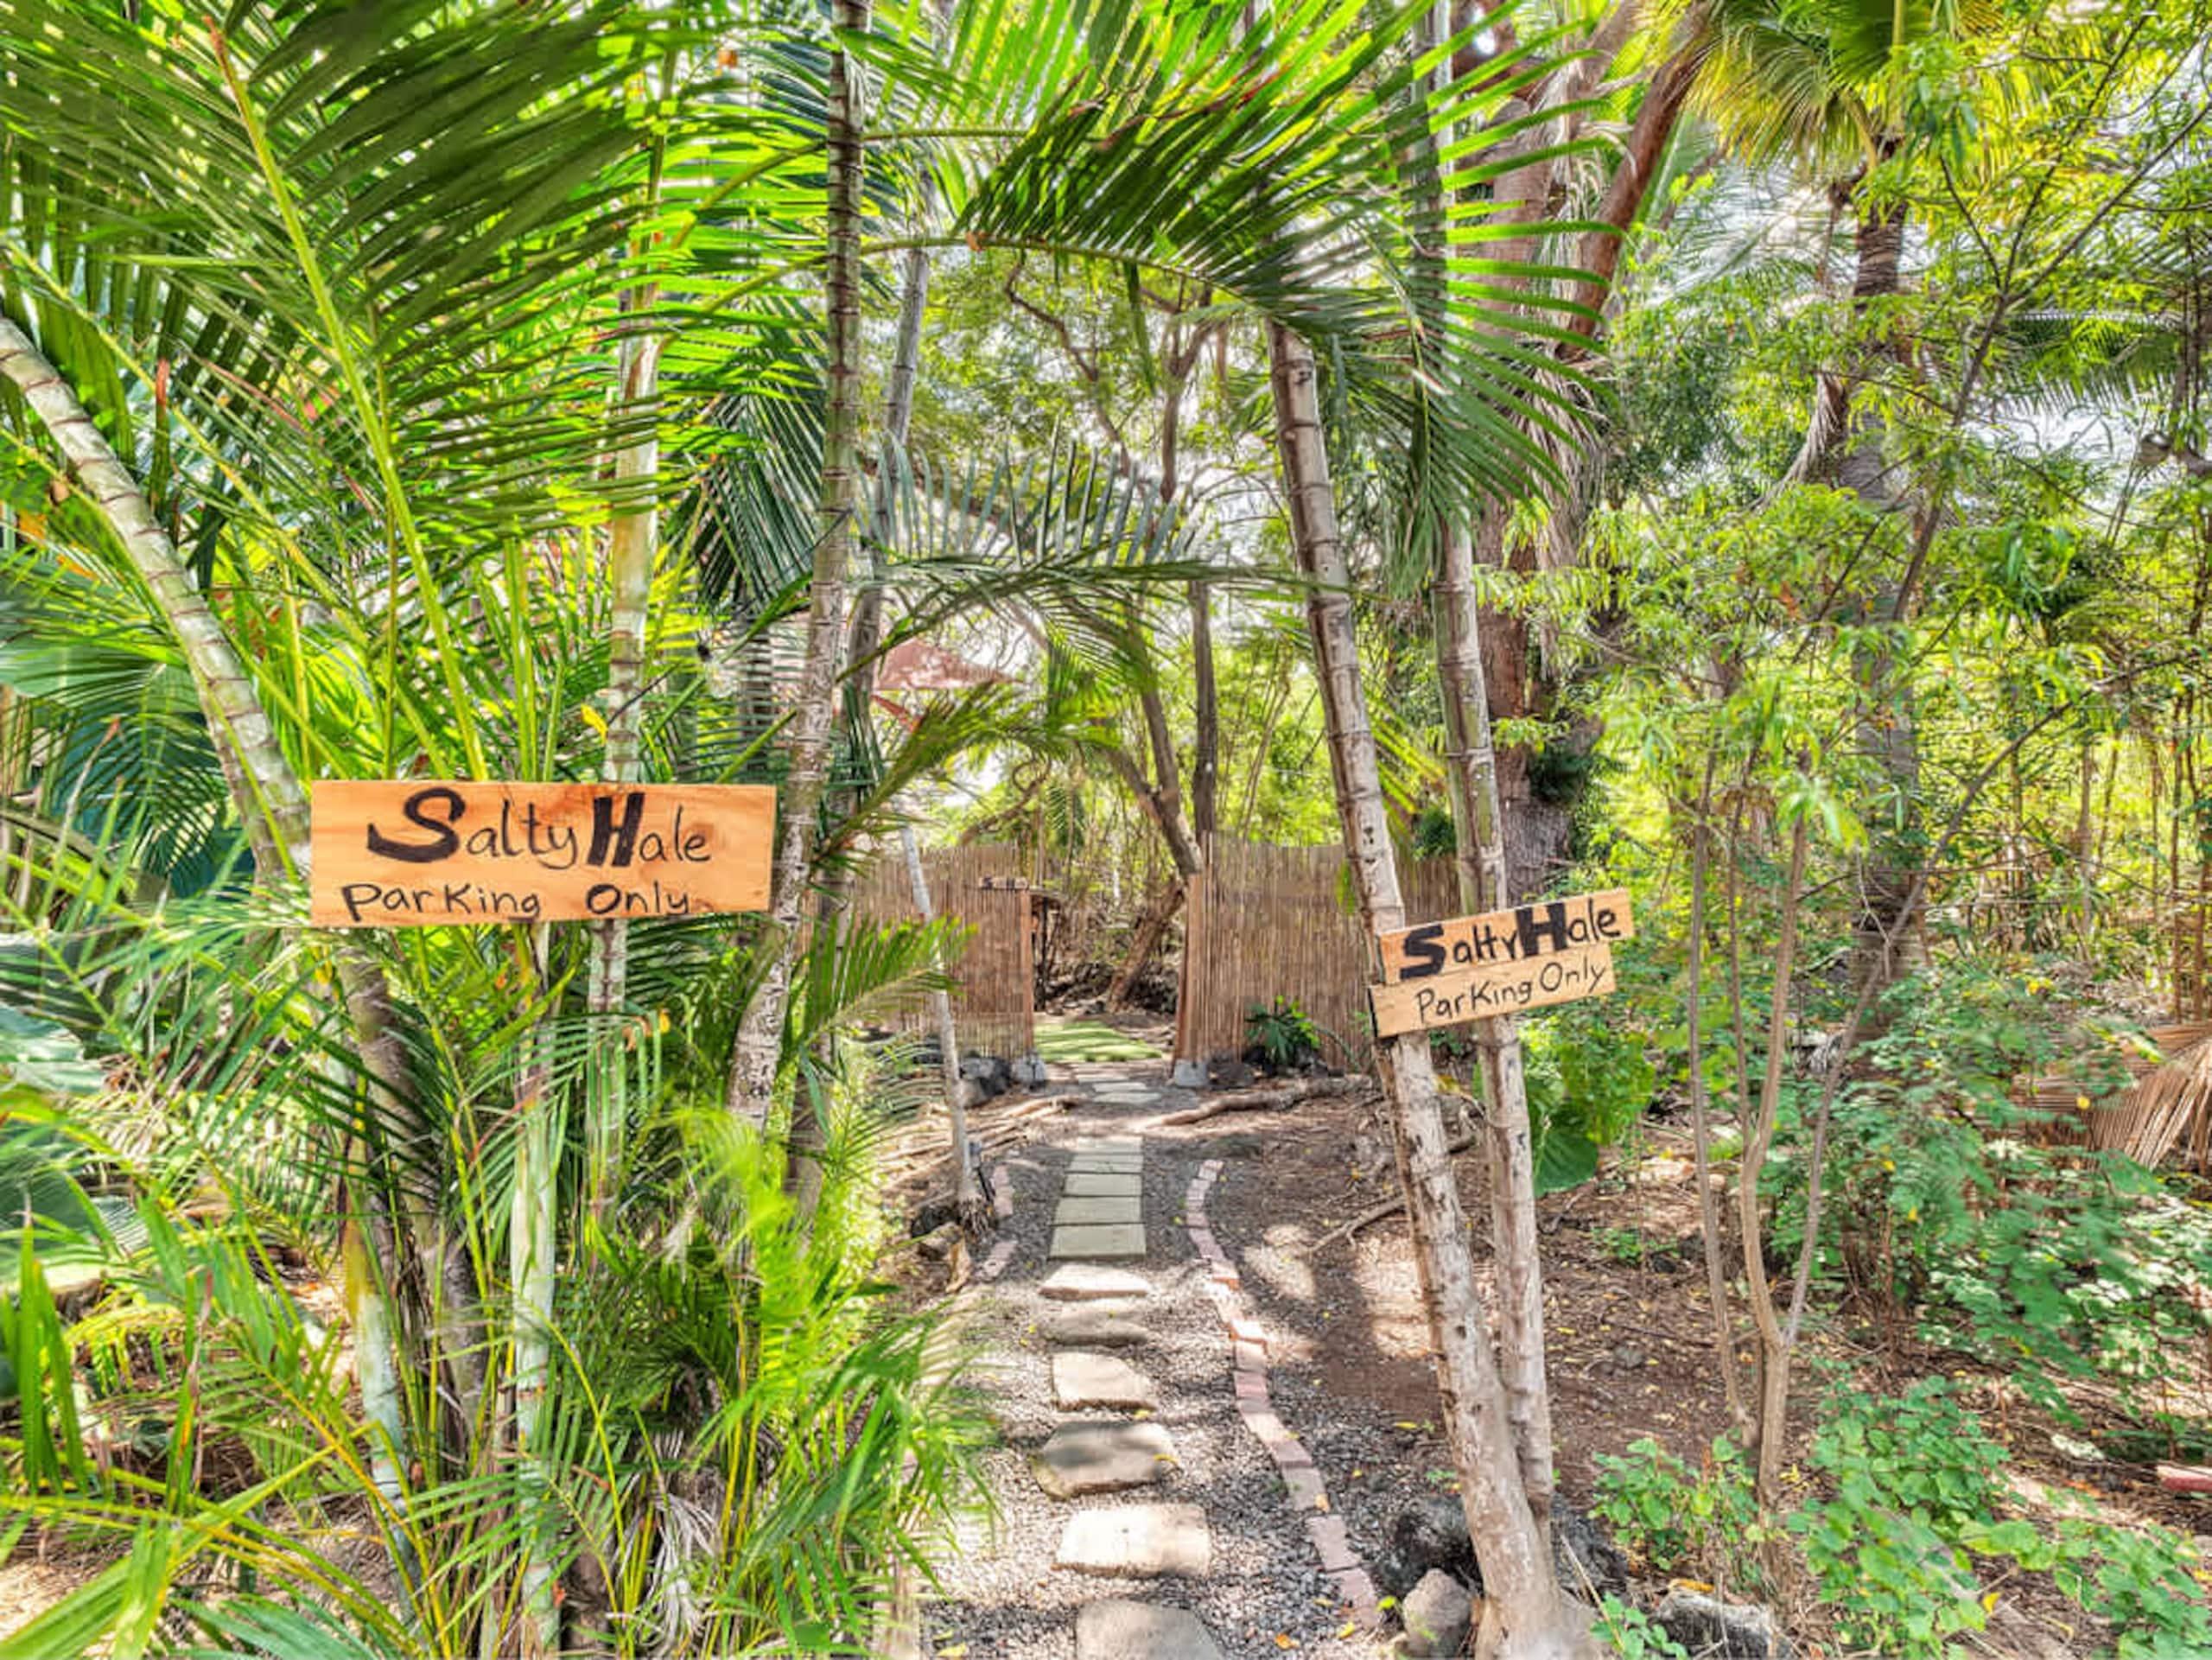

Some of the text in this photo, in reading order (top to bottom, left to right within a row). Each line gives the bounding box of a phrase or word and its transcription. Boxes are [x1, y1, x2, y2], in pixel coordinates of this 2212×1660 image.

[367, 787, 711, 870] Salty Hale
[585, 881, 690, 915] Only
[1400, 897, 1621, 980] Salty Hale
[1539, 956, 1606, 994] Only
